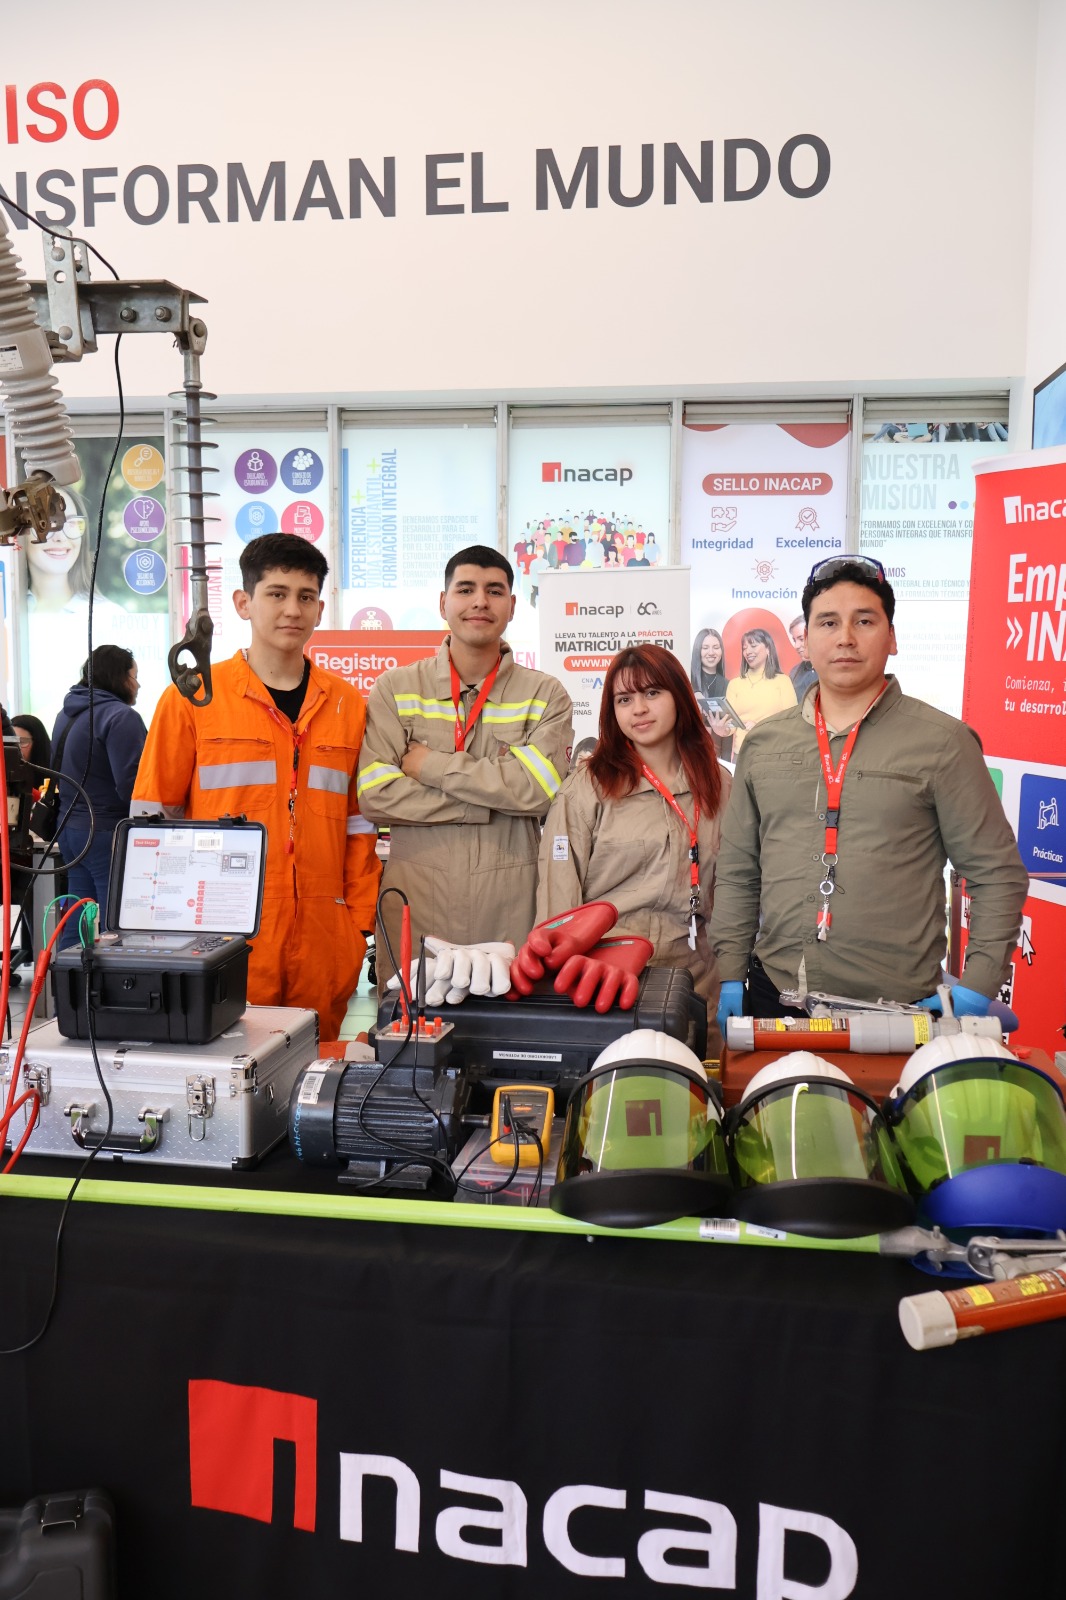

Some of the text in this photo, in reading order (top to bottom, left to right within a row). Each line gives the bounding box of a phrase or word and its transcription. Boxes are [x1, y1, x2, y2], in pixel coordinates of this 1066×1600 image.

[425, 151, 509, 216] EL
[535, 133, 831, 211] MUNDO
[862, 453, 960, 481] NUESTRA
[381, 448, 397, 511] INTEGRAL
[713, 477, 822, 491] SELLO INACAP
[861, 482, 937, 511] MISIÓN
[367, 474, 382, 557] ESTUDIANTIL
[440, 515, 469, 524] ESPACIOS
[470, 515, 479, 524] DE
[402, 524, 466, 533] DESARROLLO PARA EL
[902, 520, 916, 529] CON
[917, 520, 957, 529] EXCELENCIA
[957, 520, 963, 528] Y
[964, 519, 973, 528] CO
[860, 528, 973, 539] PERSONAS ÍNTEGRAS QUE TRANSFO
[351, 506, 366, 589] EXPERIENCIA
[416, 543, 423, 551] EL
[424, 543, 443, 551] SELLO
[444, 543, 455, 551] DEL
[691, 537, 754, 552] Integridad
[776, 536, 842, 549] Excelencia
[402, 552, 439, 560] ESTUDIANTE
[367, 559, 381, 588] VIDA
[893, 579, 921, 588] INTEGRAL
[922, 579, 930, 588] EN
[931, 579, 940, 588] LO
[941, 578, 965, 588] TÉCNICO
[1007, 553, 1066, 613] Emp
[731, 586, 798, 599] Innovación
[905, 589, 939, 598] FORMACIÓN
[637, 629, 673, 637] PRÁCTICA
[1026, 610, 1066, 662] IN
[314, 653, 398, 675] Registro
[571, 658, 612, 668] WWW.IN
[1005, 675, 1055, 693] Comienza,
[1004, 698, 1016, 711] tu
[1032, 846, 1064, 863] Prácticas
